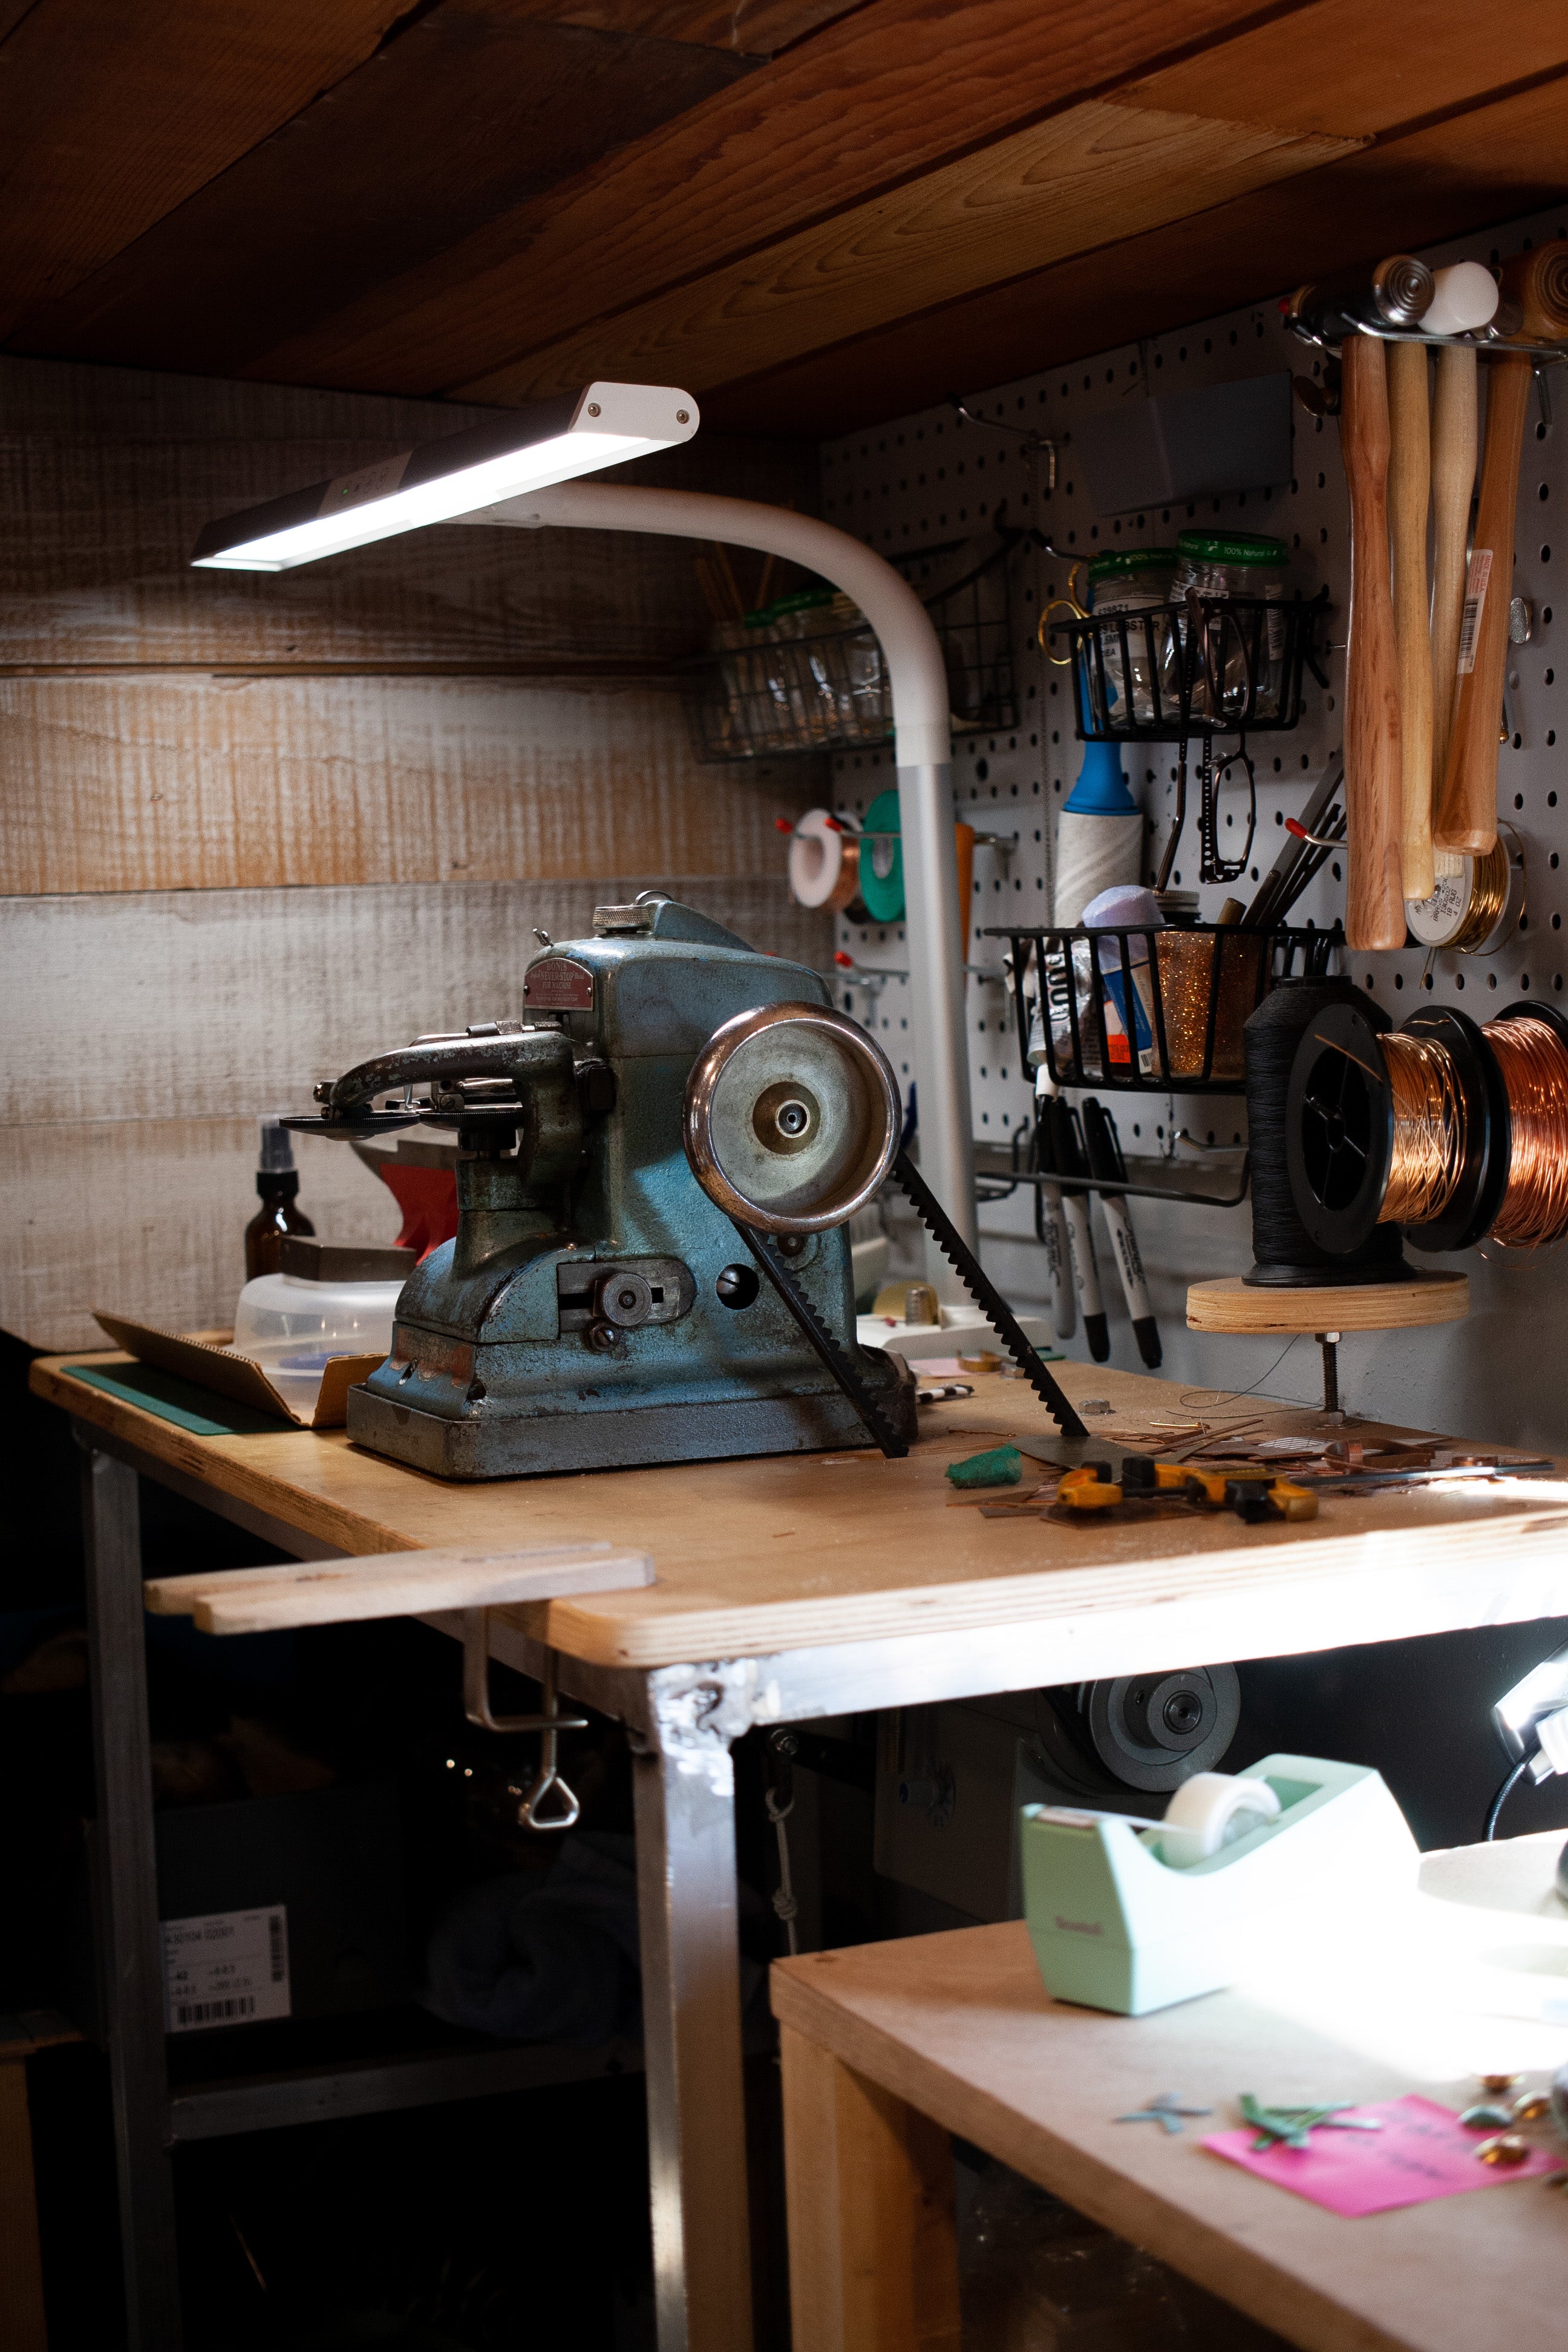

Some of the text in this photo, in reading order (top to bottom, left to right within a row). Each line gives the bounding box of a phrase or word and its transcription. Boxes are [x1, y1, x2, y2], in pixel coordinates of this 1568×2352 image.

[1224, 547, 1242, 555] 100%
[1110, 620, 1160, 633] LBSTR
[1440, 886, 1451, 914] 130502
[1446, 889, 1457, 917] 18 AWG
[1455, 896, 1462, 907] OZ
[546, 961, 568, 971] BONIS
